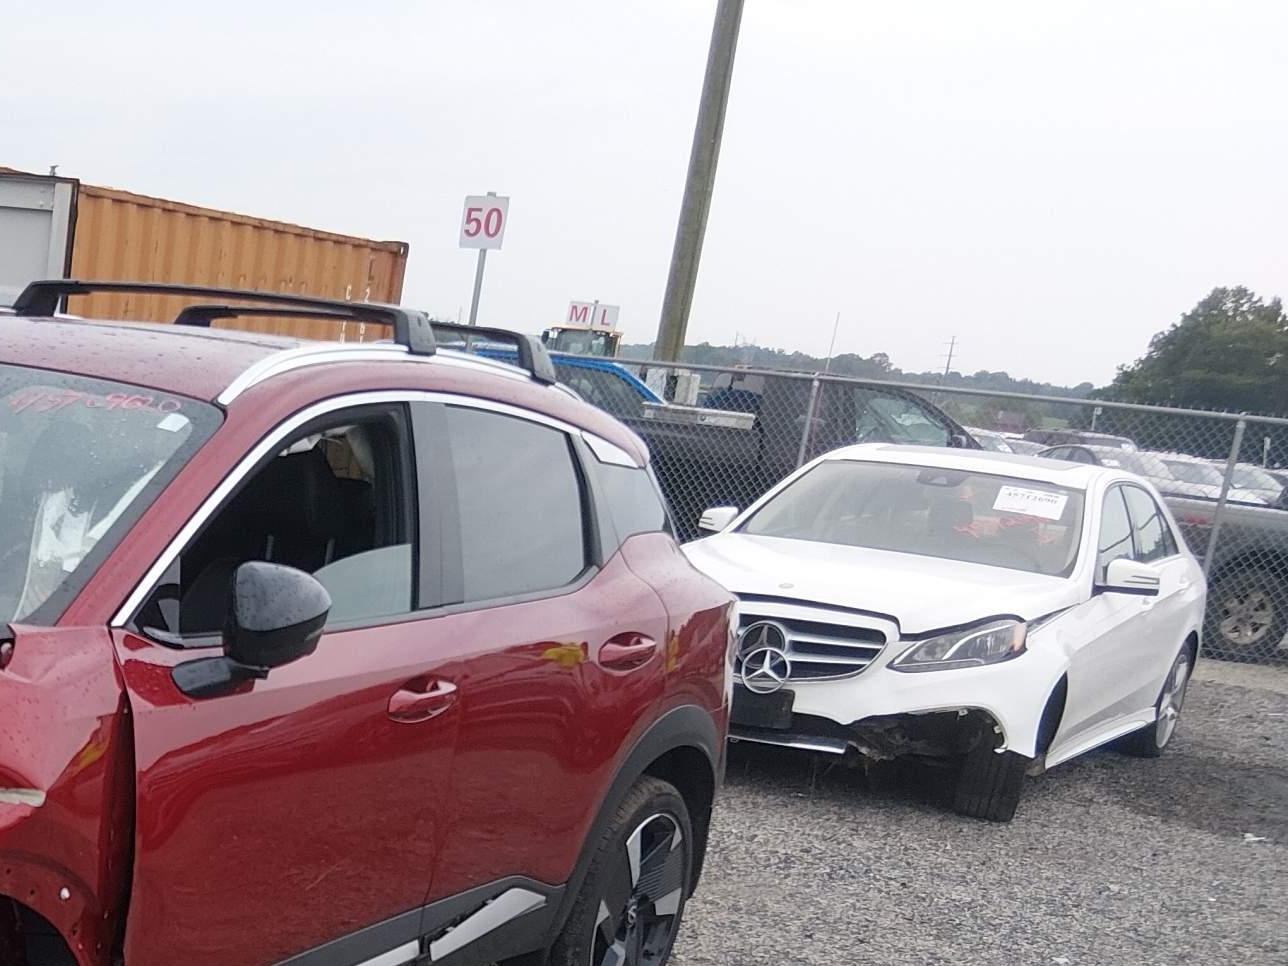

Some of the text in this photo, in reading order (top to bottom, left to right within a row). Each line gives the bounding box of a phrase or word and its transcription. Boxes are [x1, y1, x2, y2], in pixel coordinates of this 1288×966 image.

[463, 207, 503, 238] 50
[569, 304, 611, 327] M L
